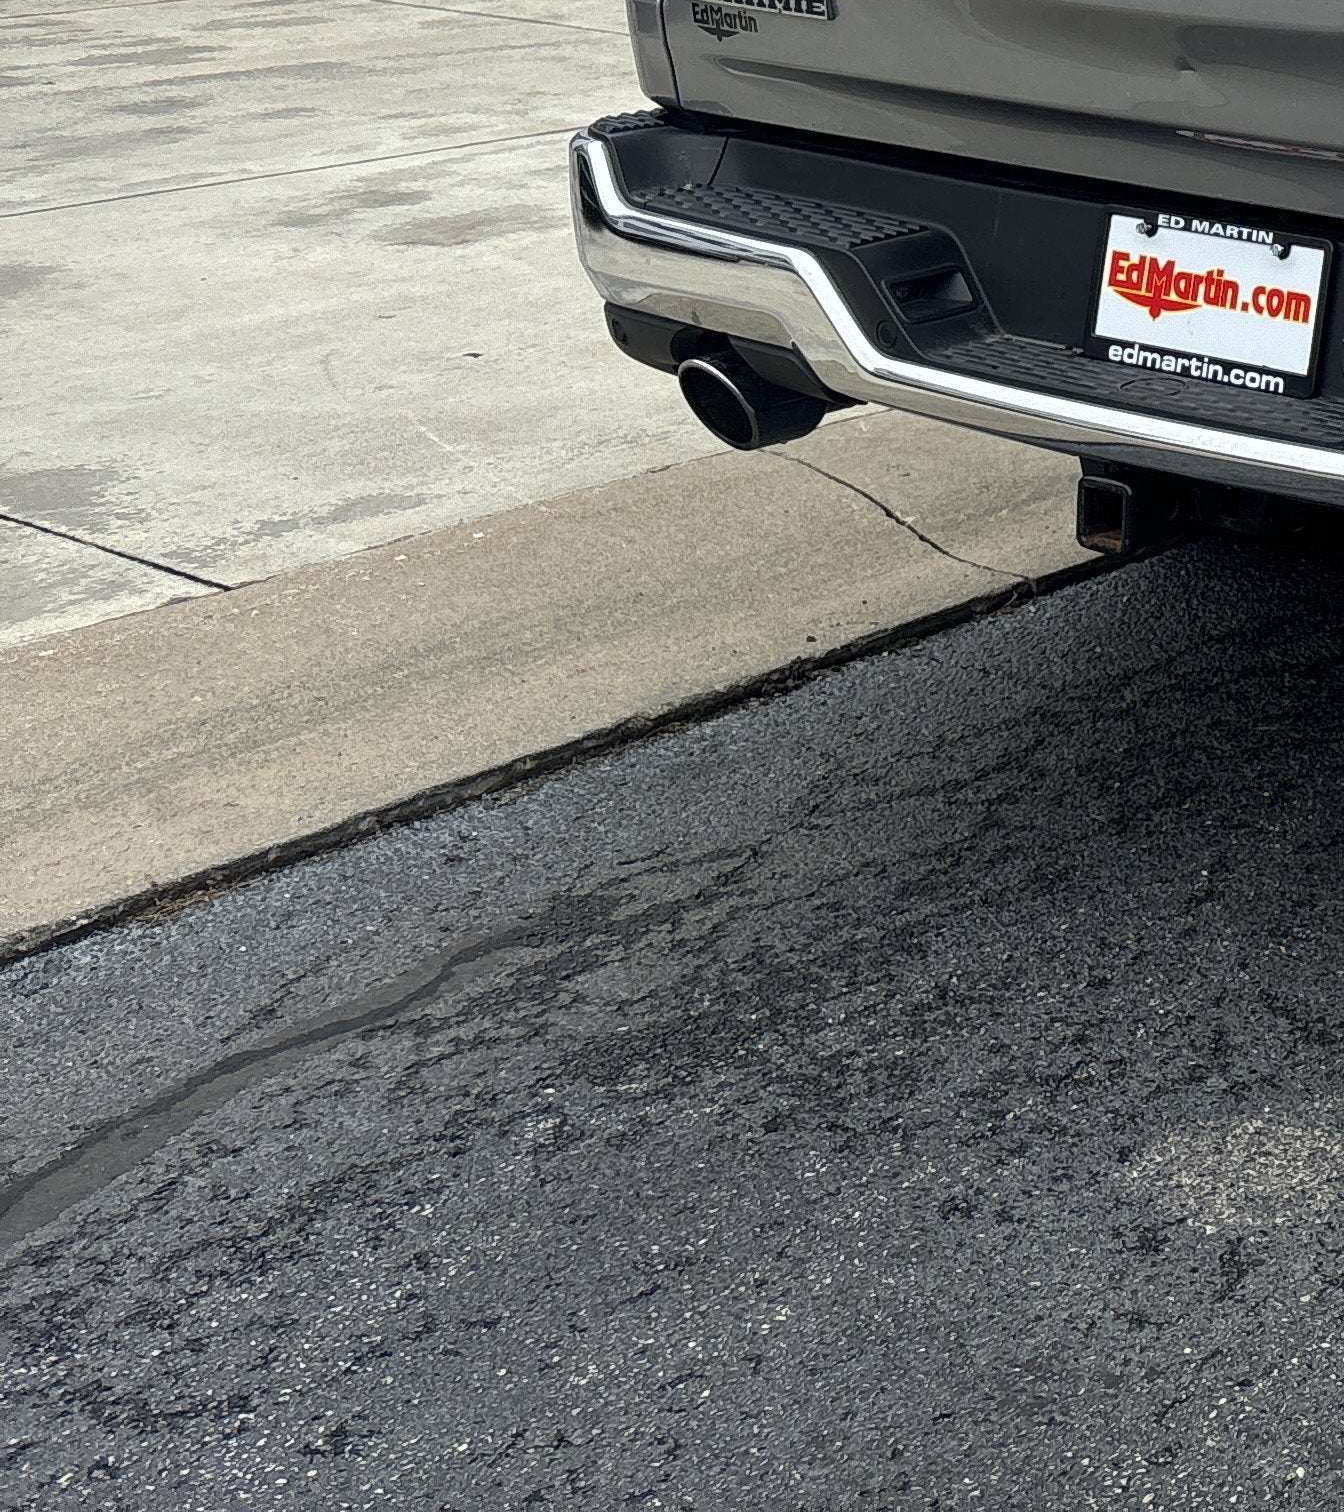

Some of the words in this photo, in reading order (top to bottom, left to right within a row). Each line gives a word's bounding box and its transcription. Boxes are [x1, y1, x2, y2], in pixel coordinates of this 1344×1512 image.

[1157, 214, 1185, 229] ED
[1191, 219, 1274, 244] MARTIN
[1107, 250, 1312, 324] EdMartin.com
[1108, 343, 1286, 394] edmartin.com
